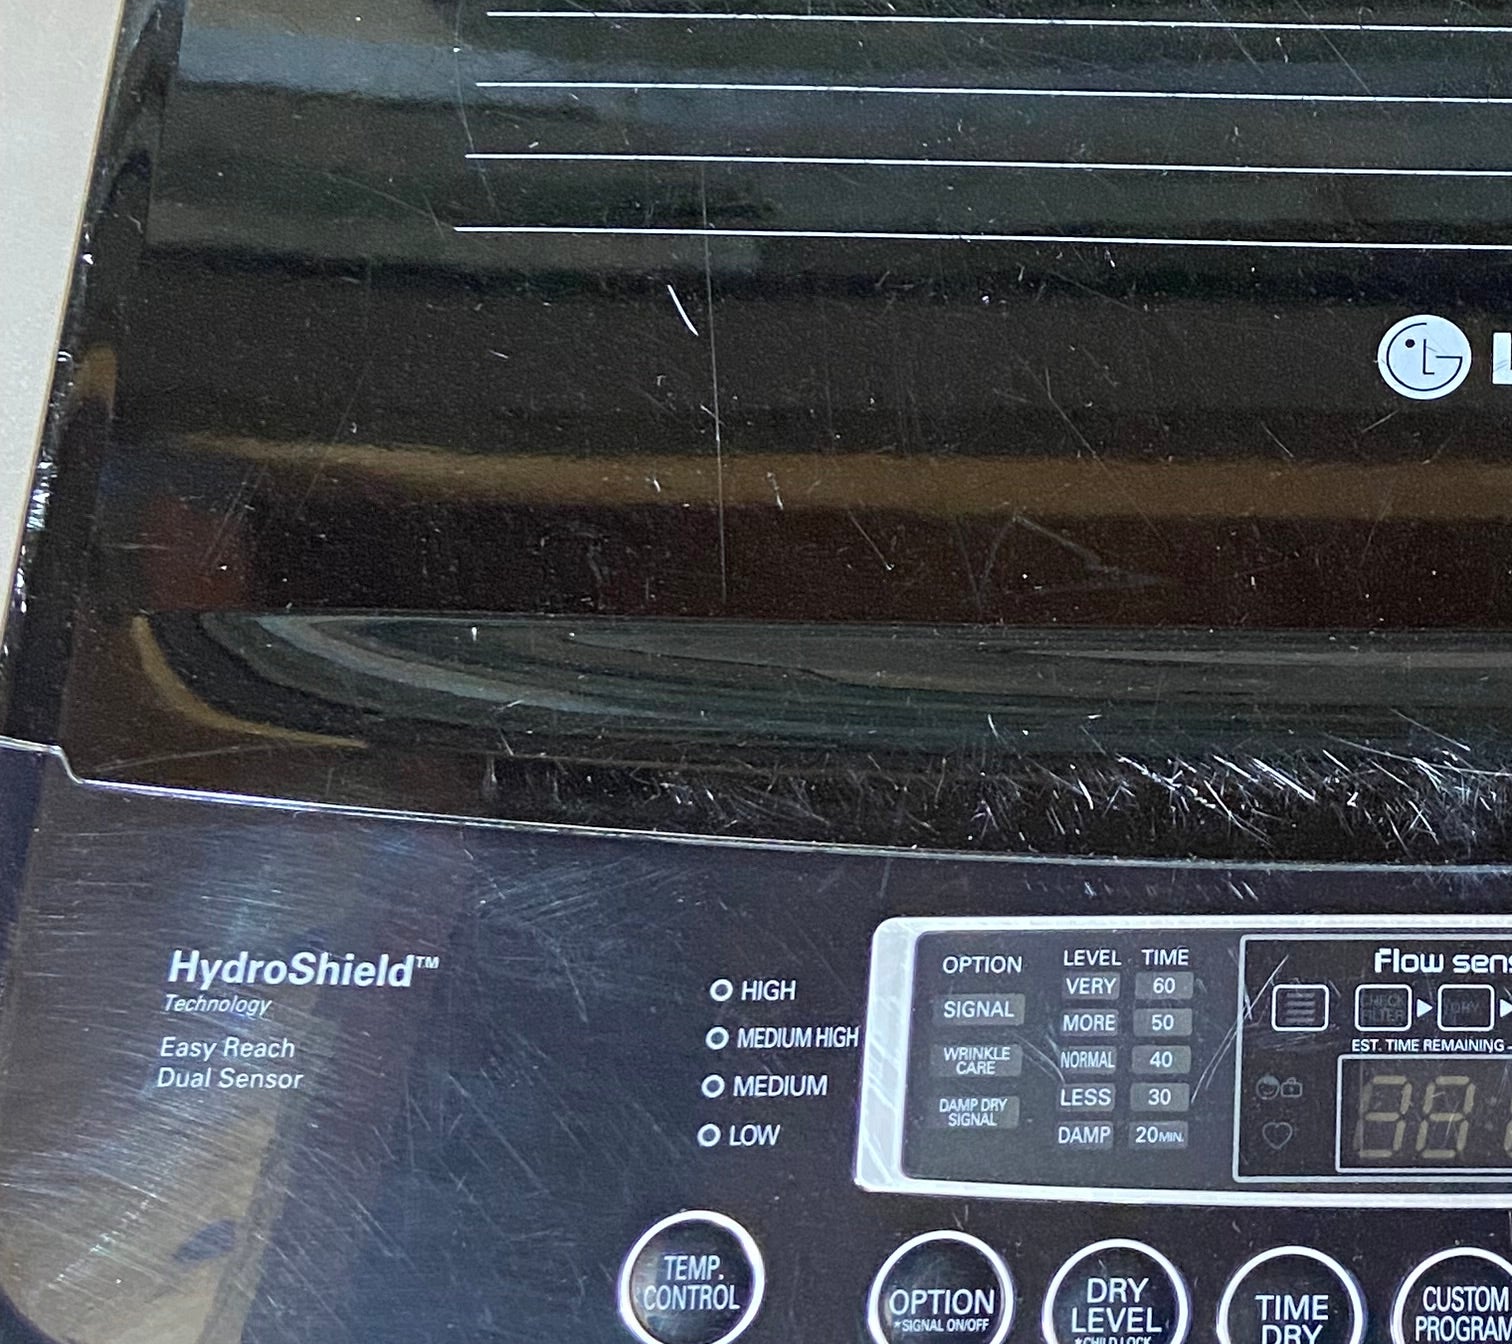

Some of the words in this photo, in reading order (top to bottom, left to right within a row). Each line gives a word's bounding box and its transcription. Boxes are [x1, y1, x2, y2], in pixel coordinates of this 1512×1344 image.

[943, 957, 1022, 974] OPTION
[1063, 950, 1121, 966] LEVEL
[1142, 949, 1189, 966] TIME
[1375, 948, 1444, 973] Flow
[741, 980, 796, 1001] HIGH
[1066, 978, 1116, 995] VERY
[1152, 978, 1175, 994] 60
[164, 994, 272, 1016] Technology
[944, 1001, 1014, 1018] SIGNAL
[1063, 1015, 1116, 1031] MORE
[1152, 1014, 1174, 1030] 50
[737, 1027, 812, 1048] MEDIUM
[815, 1026, 860, 1048] HIGH
[160, 1036, 217, 1061] Easy
[223, 1037, 295, 1058] Reach
[944, 1048, 1011, 1061] WRINKLE
[1352, 1039, 1382, 1052] EST.
[1386, 1039, 1420, 1052] TIME
[1424, 1040, 1505, 1053] REMAINING
[956, 1061, 995, 1075] CARE
[1060, 1051, 1115, 1069] NORMAL
[1150, 1052, 1173, 1067] 40
[157, 1067, 211, 1088] Dual
[218, 1068, 304, 1089] Sensor
[733, 1075, 828, 1096] MEDIUM
[940, 1099, 978, 1112] DAMP
[981, 1099, 1007, 1112] DRY
[1060, 1089, 1111, 1106] LESS
[1148, 1089, 1172, 1105] 30
[948, 1113, 997, 1126] SIGNAL
[729, 1124, 781, 1146] LOW
[1058, 1126, 1111, 1144] DAMP
[664, 1256, 725, 1281] TEMP.
[642, 1285, 741, 1311] CONTROL
[1086, 1277, 1149, 1303] DRY
[889, 1288, 994, 1314] OPTION
[1255, 1295, 1329, 1320] TIME
[1423, 1286, 1509, 1313] CUSTOM
[947, 1317, 990, 1332] ON/OFF
[1070, 1307, 1162, 1332] LEVEL
